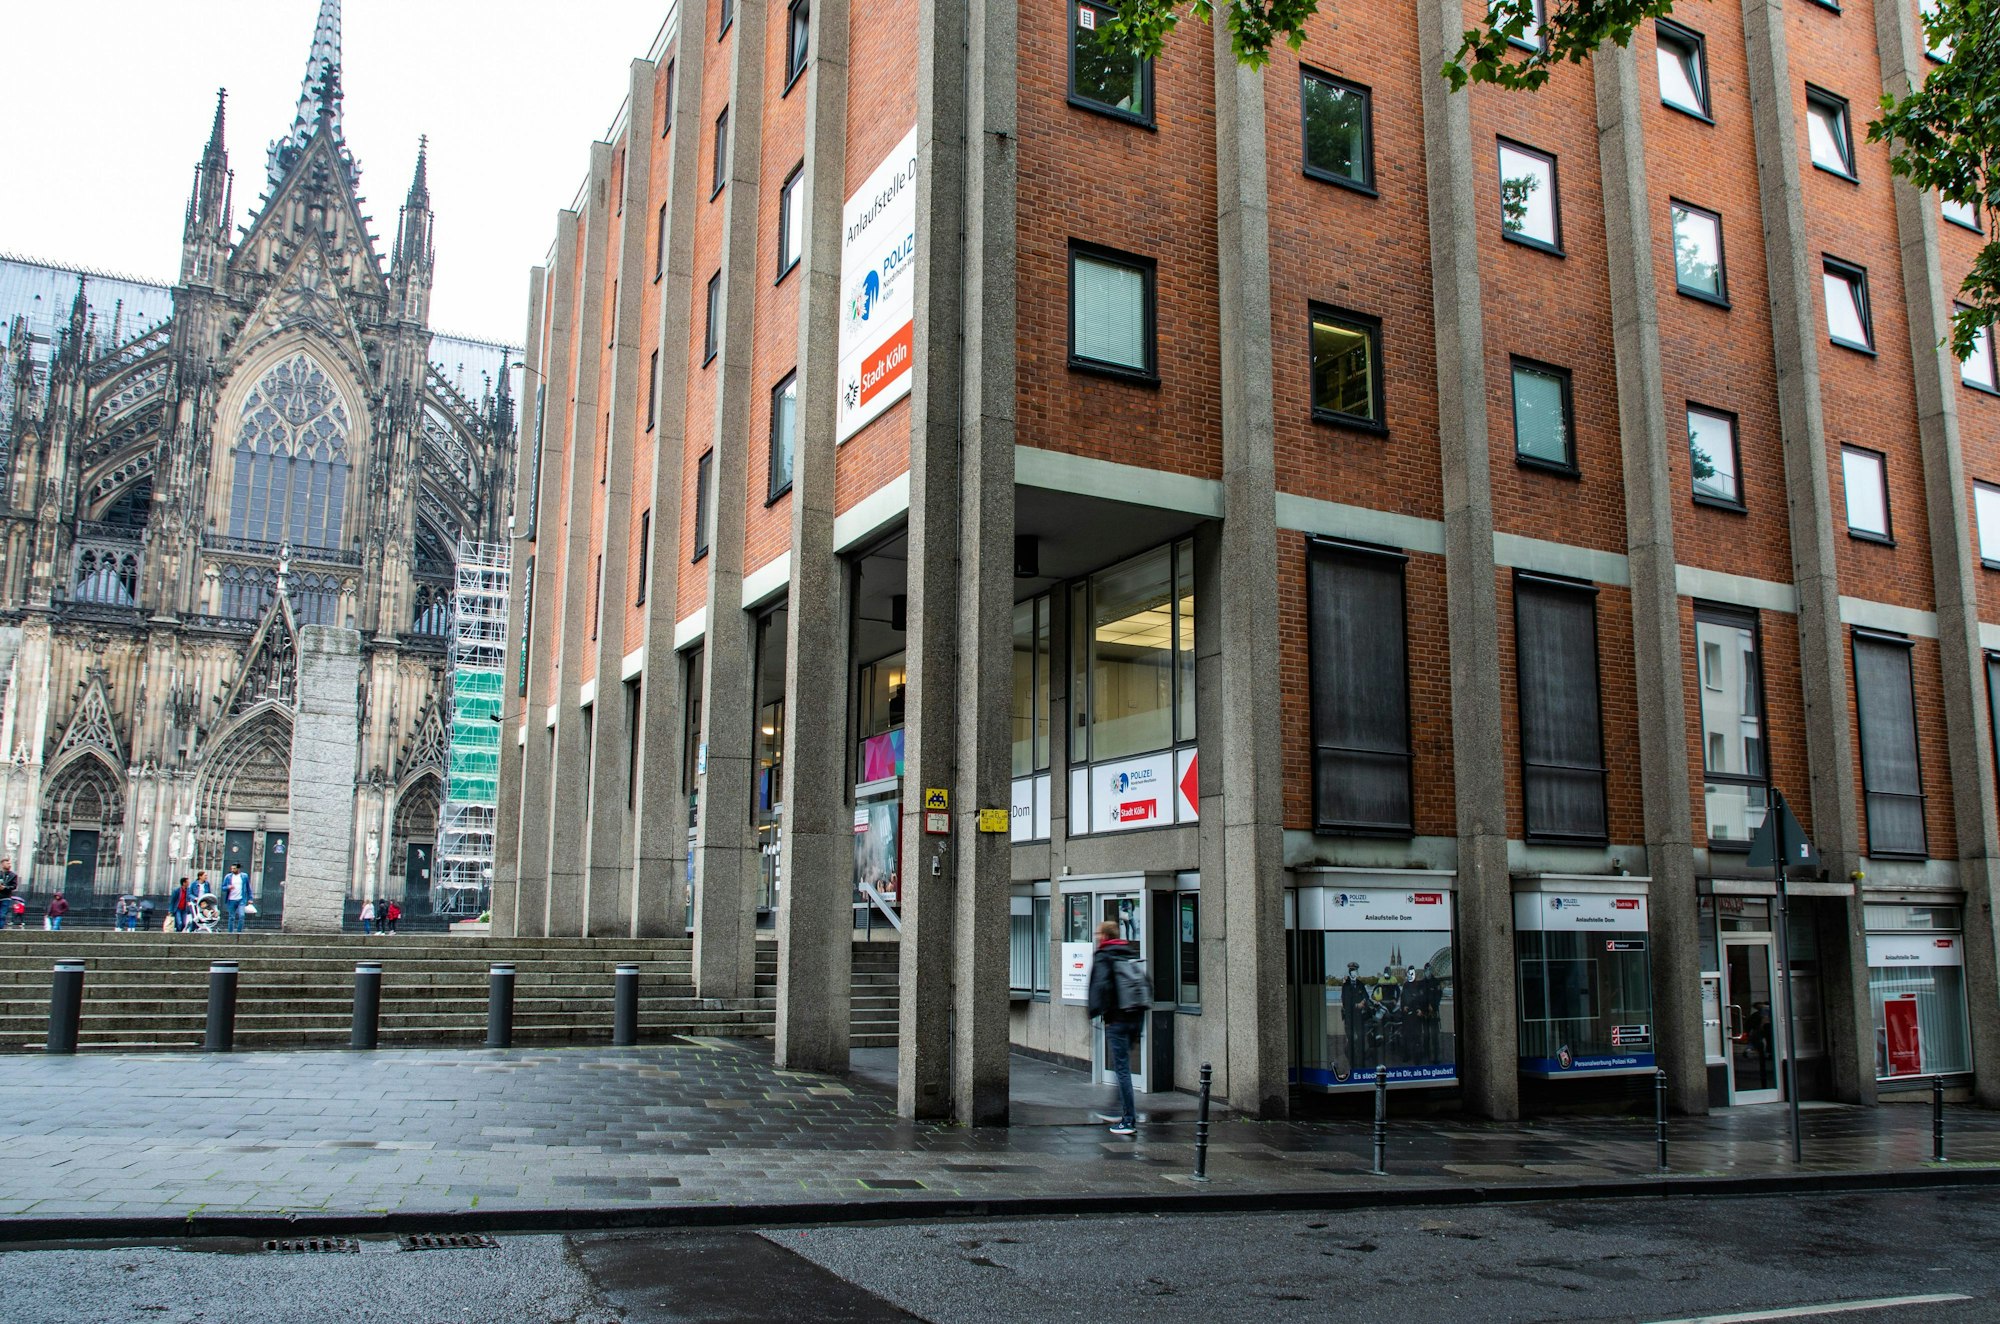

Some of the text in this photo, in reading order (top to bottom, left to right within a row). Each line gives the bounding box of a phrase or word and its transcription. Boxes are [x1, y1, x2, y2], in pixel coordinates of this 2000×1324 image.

[846, 172, 906, 248] Anlaufstelle
[861, 342, 908, 393] Stadt Köln
[1130, 769, 1153, 780] POLIZEI
[1012, 805, 1030, 818] Dom
[1120, 805, 1146, 817] Stadt Köln
[1353, 1072, 1361, 1080] Es
[1396, 1069, 1402, 1077] in
[1403, 1069, 1413, 1078] Dir,
[1414, 1068, 1422, 1076] als
[1423, 1067, 1431, 1076] Du
[1432, 1067, 1454, 1077] glaubst!
